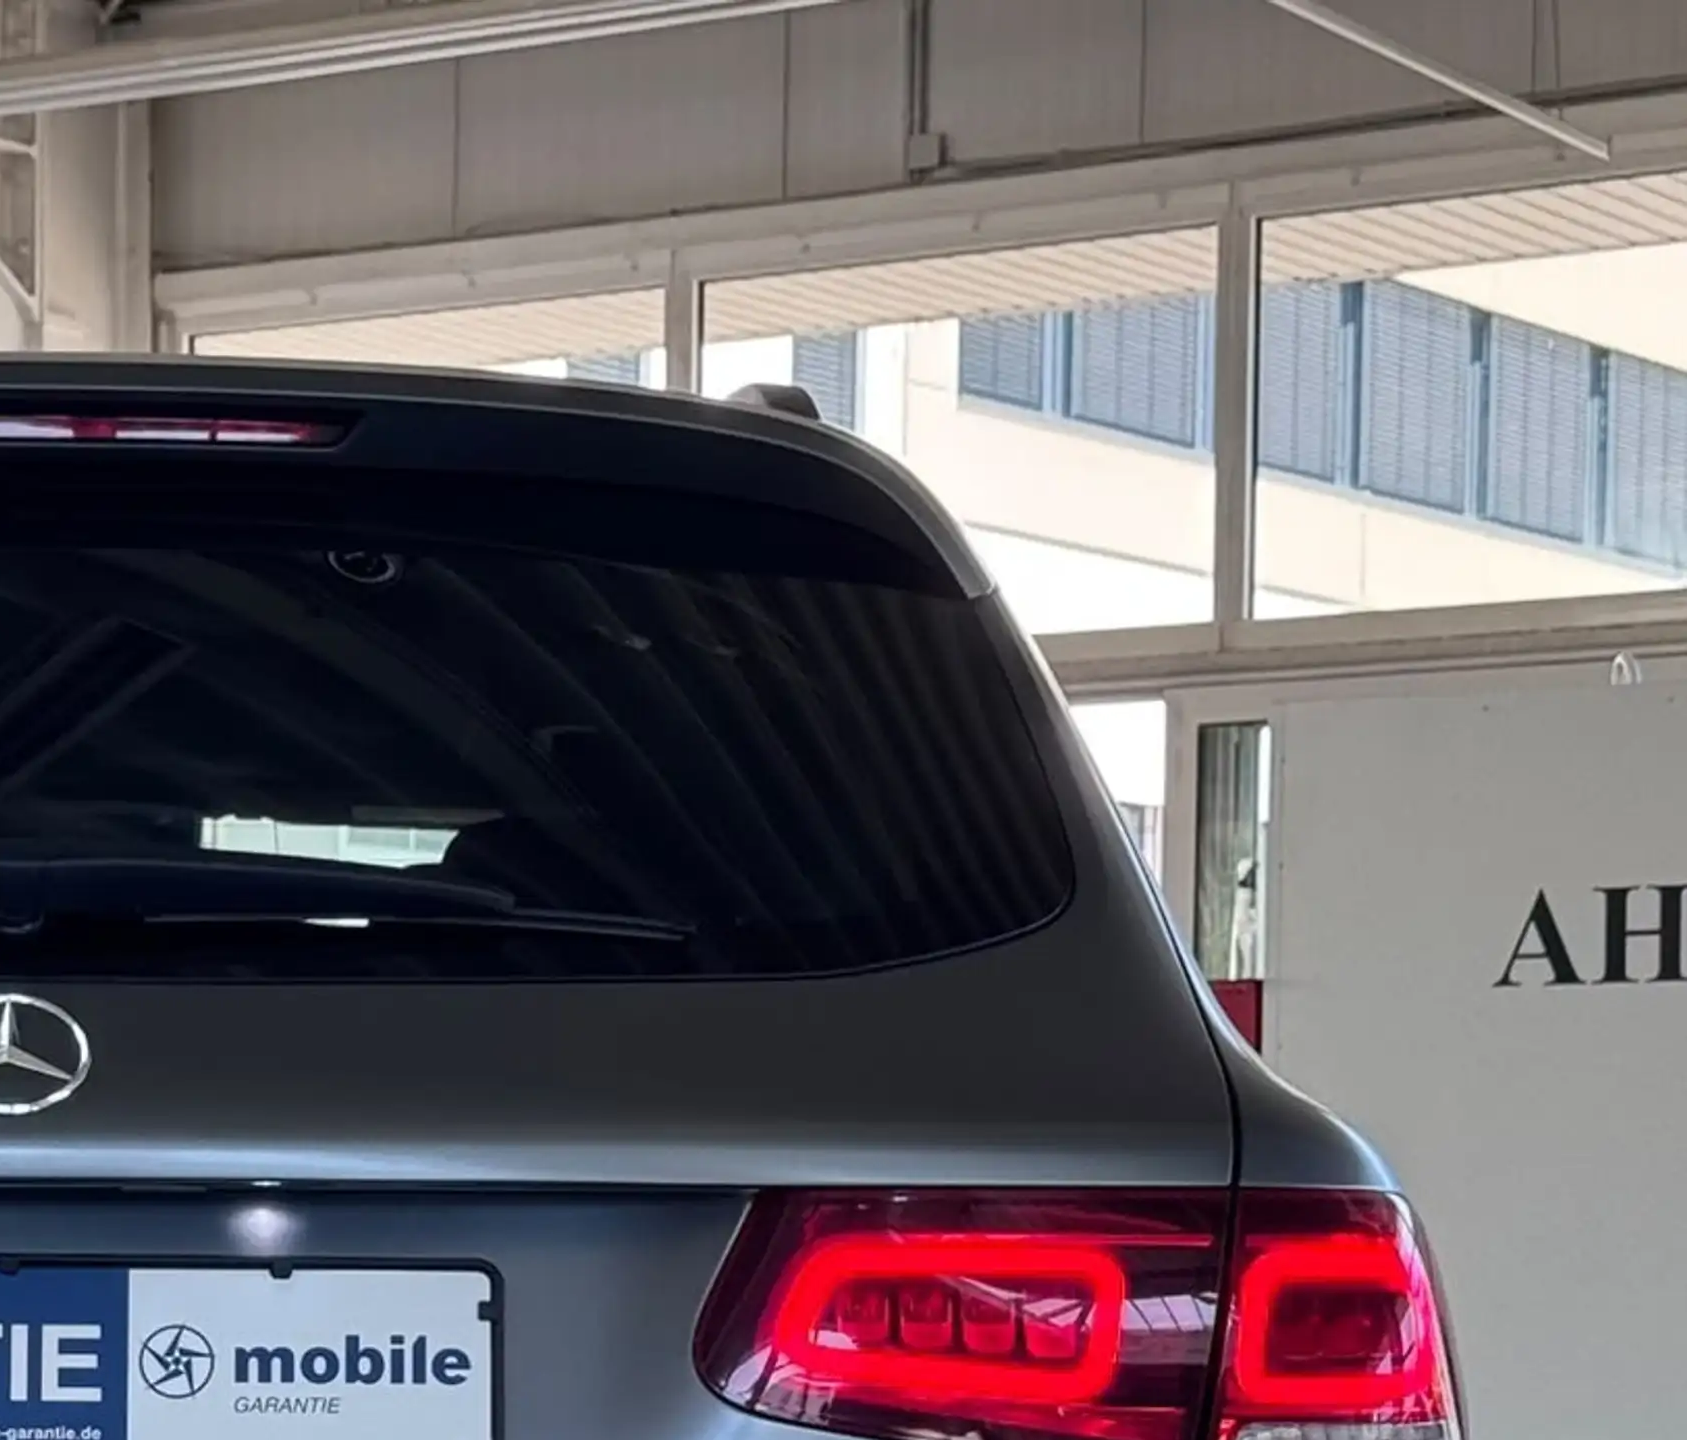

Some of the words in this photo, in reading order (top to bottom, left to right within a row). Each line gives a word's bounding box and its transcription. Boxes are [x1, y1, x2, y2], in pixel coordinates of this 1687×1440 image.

[1491, 883, 1687, 988] AH
[233, 1334, 472, 1386] mobile
[233, 1396, 341, 1415] GARANTIE
